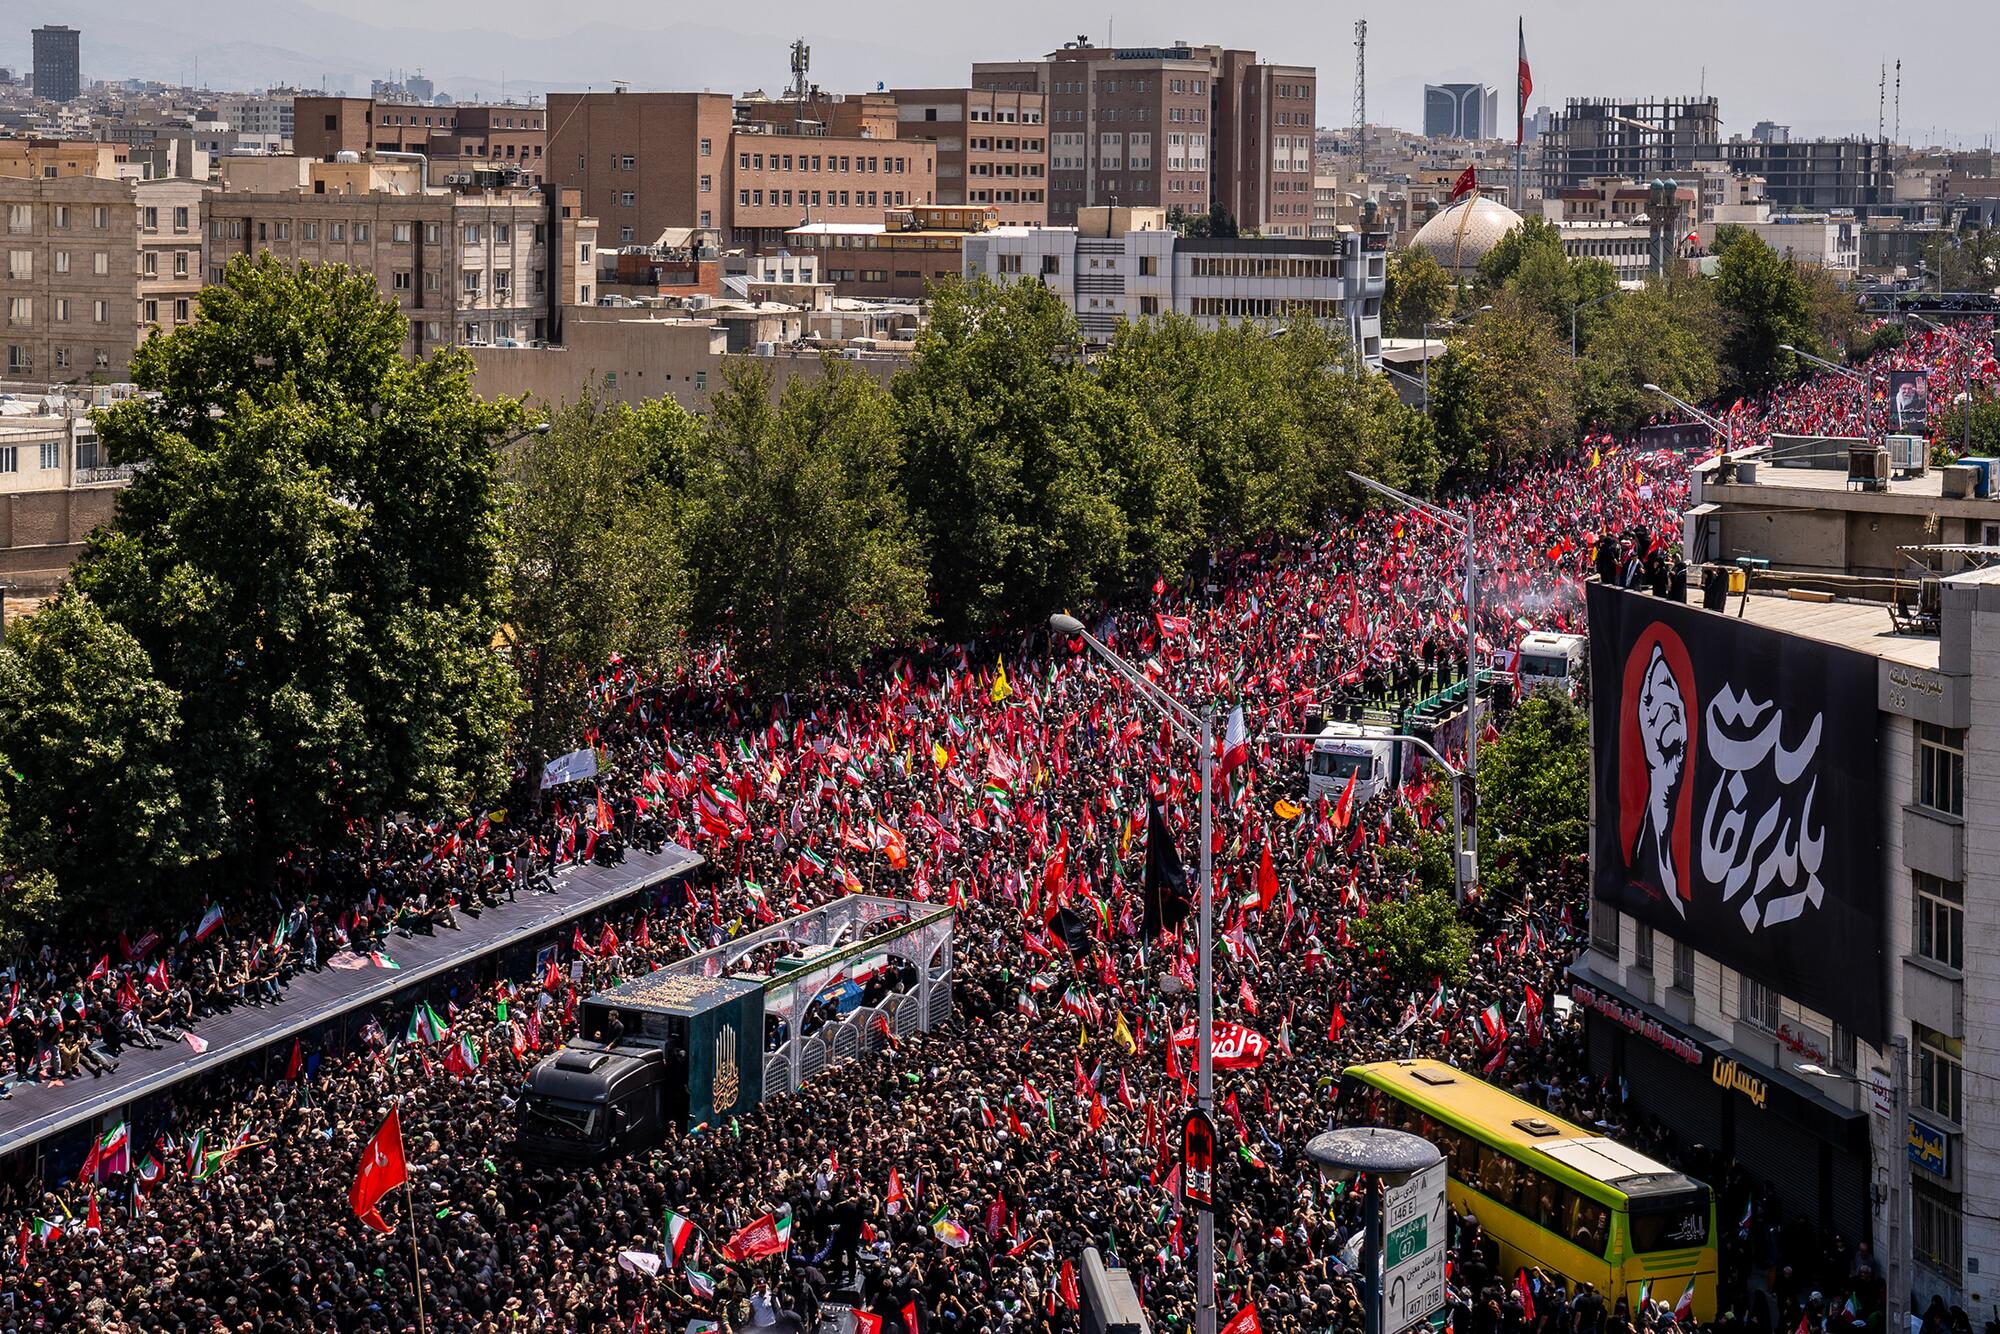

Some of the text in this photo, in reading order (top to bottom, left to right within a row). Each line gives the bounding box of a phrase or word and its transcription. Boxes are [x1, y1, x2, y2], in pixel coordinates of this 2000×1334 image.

[1740, 774, 1826, 934] باید
[1393, 1202, 1413, 1221] 146 E
[1401, 1241, 1411, 1256] 47
[1408, 1299, 1421, 1316] 417
